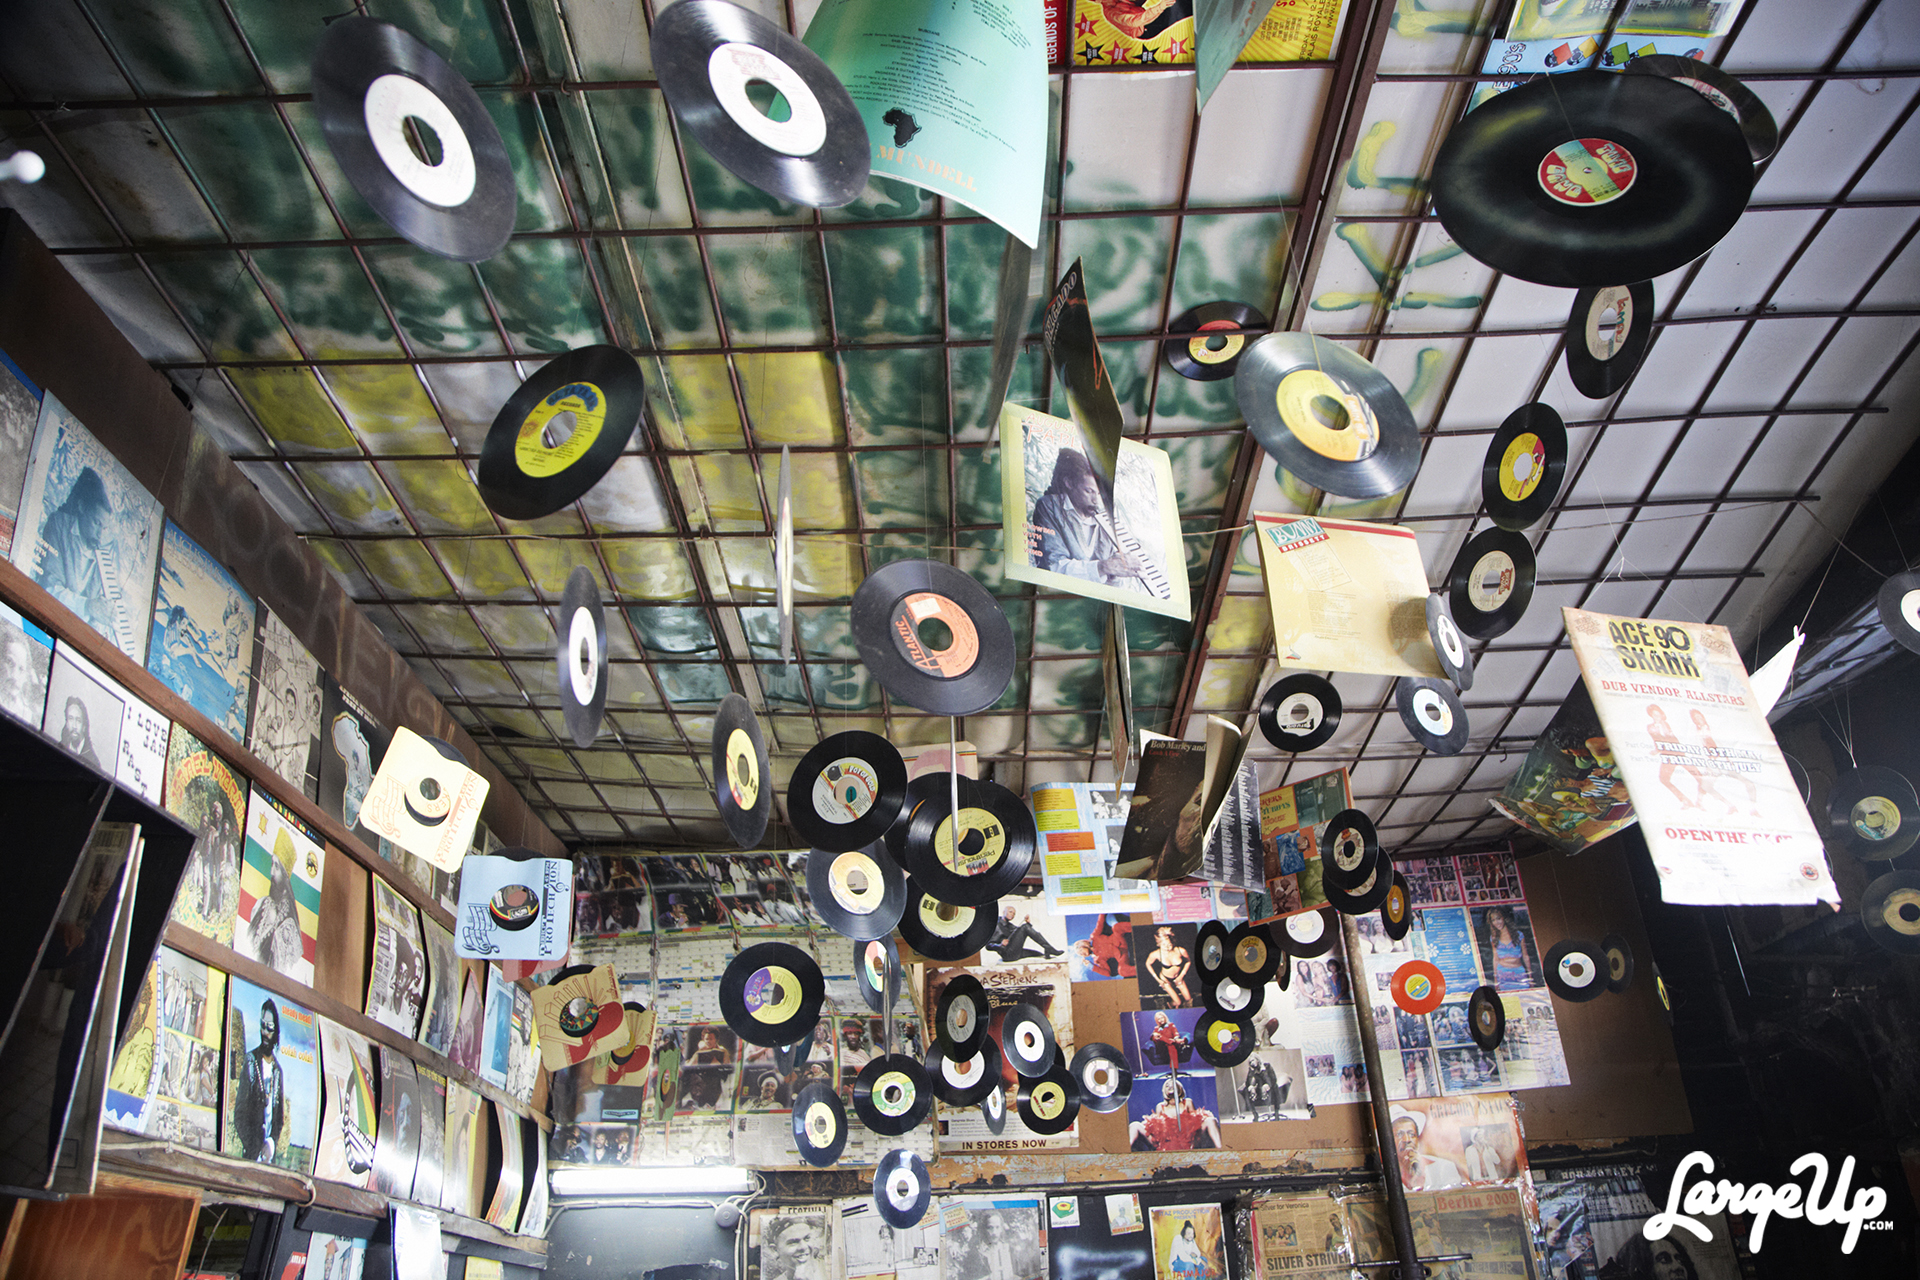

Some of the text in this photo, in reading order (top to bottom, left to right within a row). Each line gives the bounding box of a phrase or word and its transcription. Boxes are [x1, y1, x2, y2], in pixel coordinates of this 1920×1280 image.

[1044, 5, 1057, 64] LEGENDS OF
[876, 144, 977, 193] MUNDELL
[1022, 523, 1056, 535] BLOWING
[1023, 531, 1042, 541] WITH
[1274, 518, 1325, 543] BUNNY
[1024, 539, 1038, 547] THE
[1024, 548, 1043, 557] WIND
[1281, 535, 1326, 552] BRISSETT
[894, 619, 942, 670] ATLANTIC
[1609, 621, 1654, 647] ACE
[1654, 625, 1690, 651] 90
[1616, 645, 1701, 678] SKANK
[1601, 680, 1628, 692] DUB
[1631, 683, 1680, 698] VENDOR
[1686, 690, 1746, 706] ALLSTARS
[127, 706, 168, 743] I LOVE
[143, 736, 166, 759] JAH
[1150, 740, 1207, 753] Bob Marley and
[1655, 741, 1700, 754] FRIDAY
[1703, 746, 1737, 758] 13TH
[1737, 748, 1763, 761] MAY
[1660, 754, 1707, 768] FRIDAY
[1733, 761, 1762, 773] JULY
[170, 750, 213, 806] ISRAEL
[1665, 827, 1713, 842] OPEN
[1714, 830, 1749, 844] THE
[962, 1139, 1047, 1150] IN STORES NOW
[1284, 1202, 1310, 1210] Veronica
[1437, 1191, 1518, 1210] Berlin 2009
[1267, 1256, 1304, 1271] SILVER
[1470, 1262, 1494, 1273] NEW
